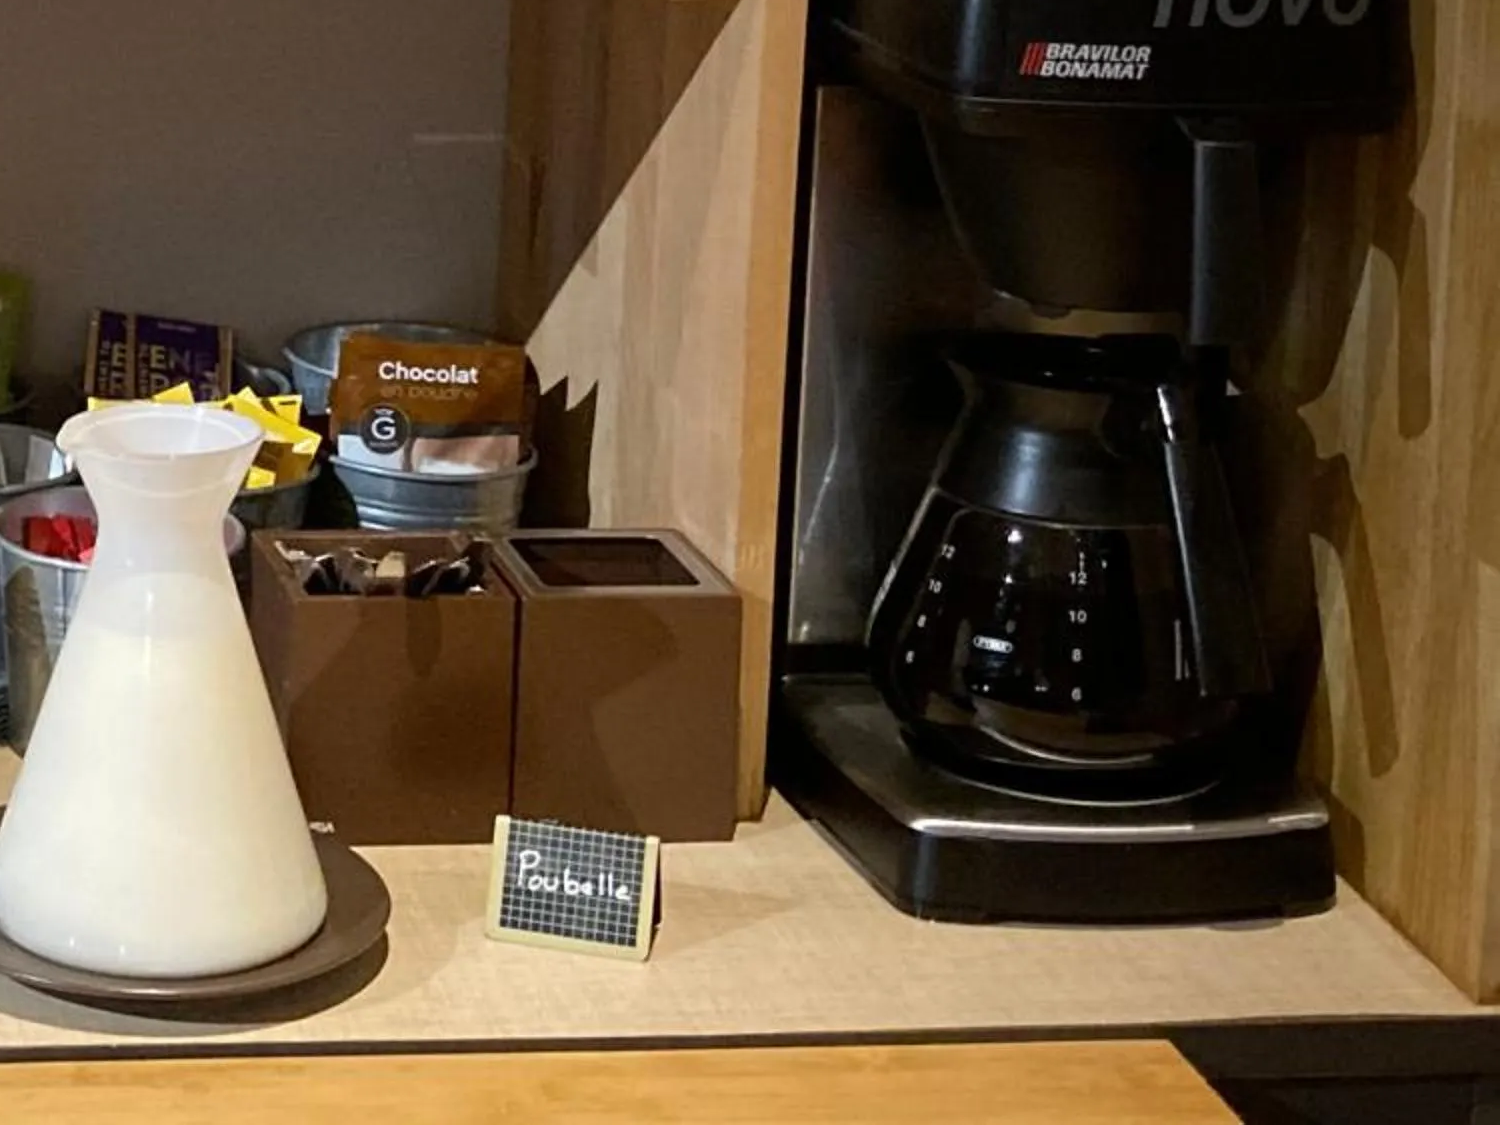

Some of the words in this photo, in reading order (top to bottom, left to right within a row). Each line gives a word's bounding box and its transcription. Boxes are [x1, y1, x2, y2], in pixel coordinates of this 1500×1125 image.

[1045, 42, 1152, 62] BRAVILOR
[1040, 60, 1150, 81] BONAMAT
[379, 361, 479, 384] Chocolat
[372, 417, 396, 440] G
[1068, 571, 1088, 586] 12
[1068, 610, 1088, 624] 10
[1071, 648, 1083, 663] 8
